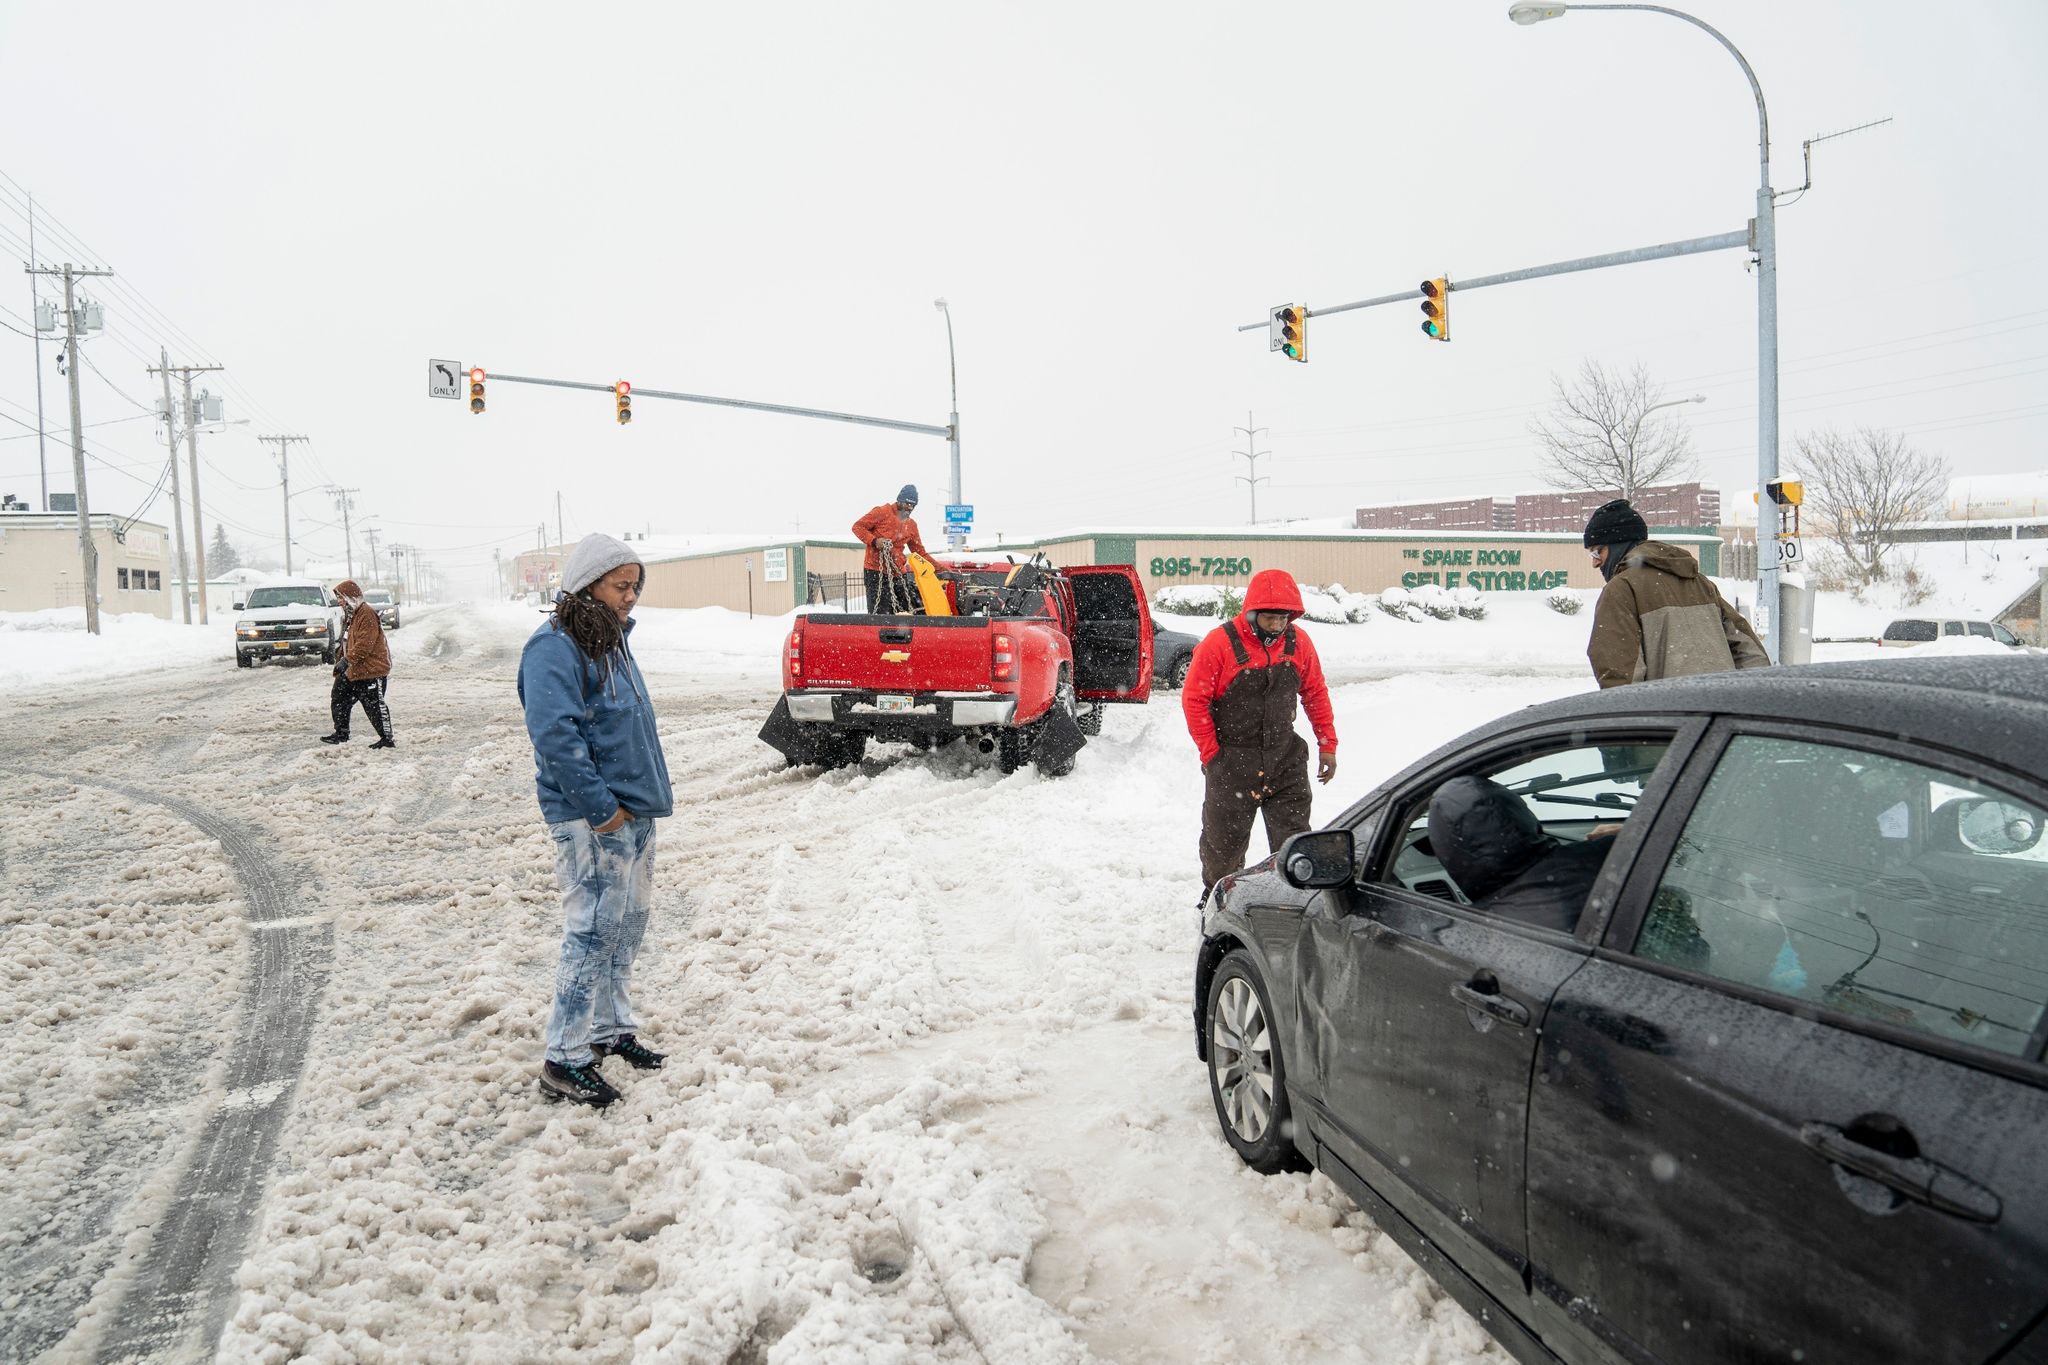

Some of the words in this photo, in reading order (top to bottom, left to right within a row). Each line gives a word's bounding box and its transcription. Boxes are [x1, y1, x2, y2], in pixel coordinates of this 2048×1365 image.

[434, 387, 456, 396] ONLY
[1150, 556, 1252, 577] 895-7250
[1402, 549, 1420, 559] THE
[1422, 548, 1473, 567] SPARE
[1476, 549, 1522, 566] ROOM
[1402, 570, 1461, 591] SELF
[1467, 570, 1569, 591] STORAGE
